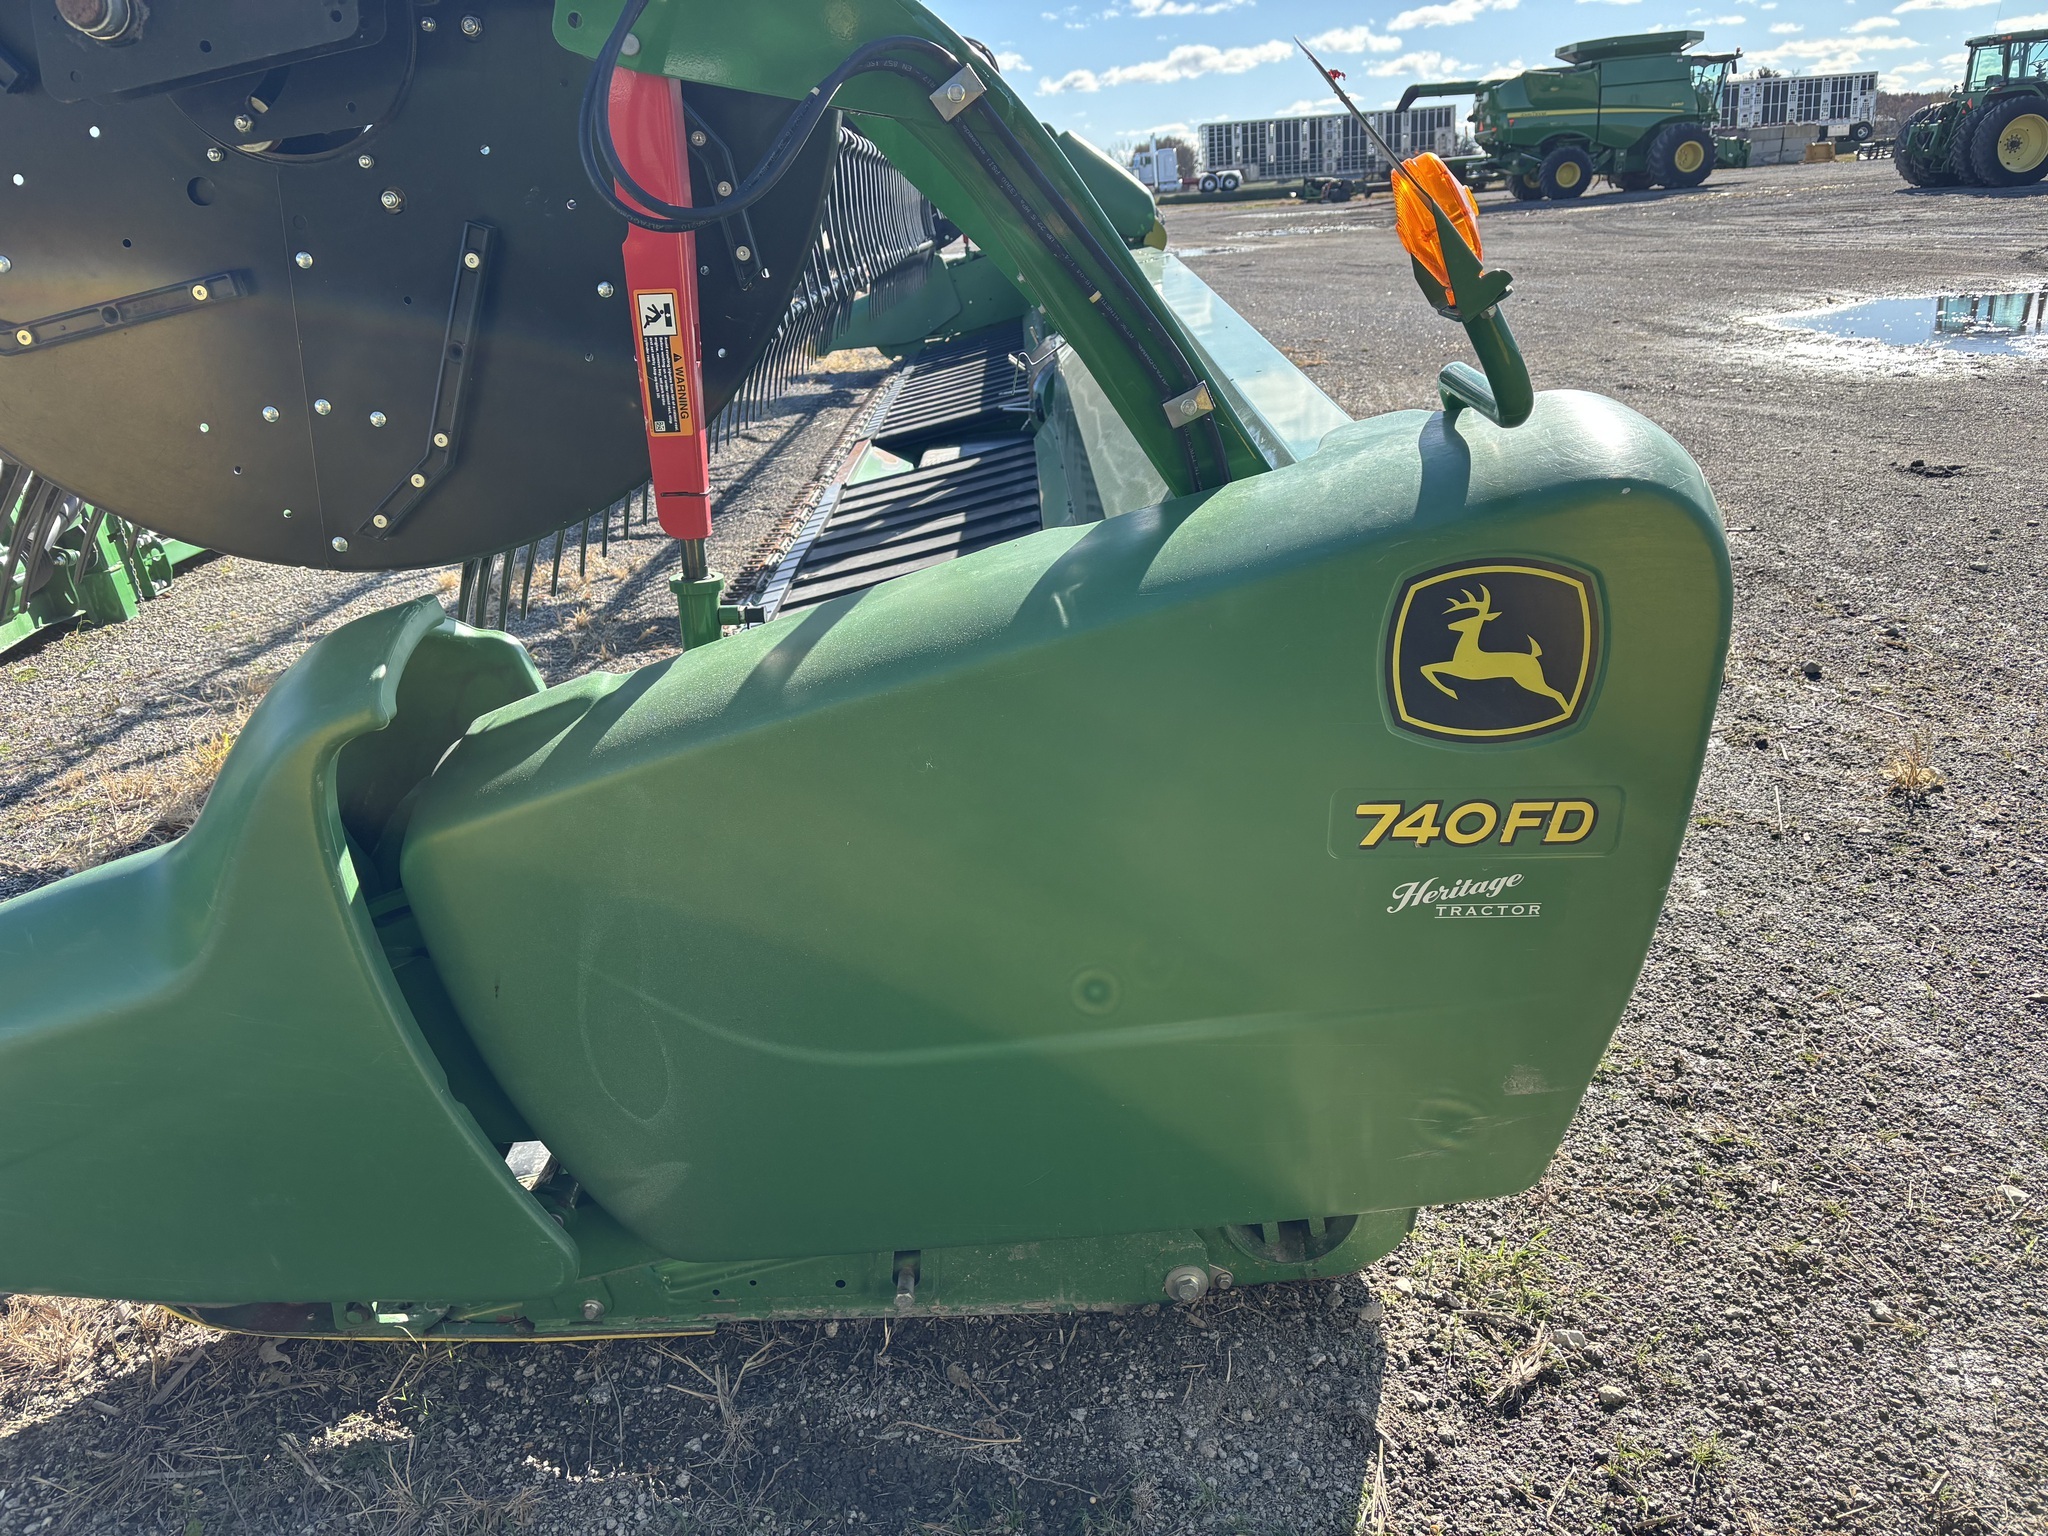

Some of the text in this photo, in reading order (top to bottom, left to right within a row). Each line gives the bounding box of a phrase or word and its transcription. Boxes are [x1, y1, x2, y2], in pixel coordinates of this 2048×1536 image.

[674, 366, 689, 419] WARNING
[1355, 799, 1599, 848] 740FD
[1387, 873, 1525, 914] Heritage
[1436, 904, 1542, 916] TRACTOR
